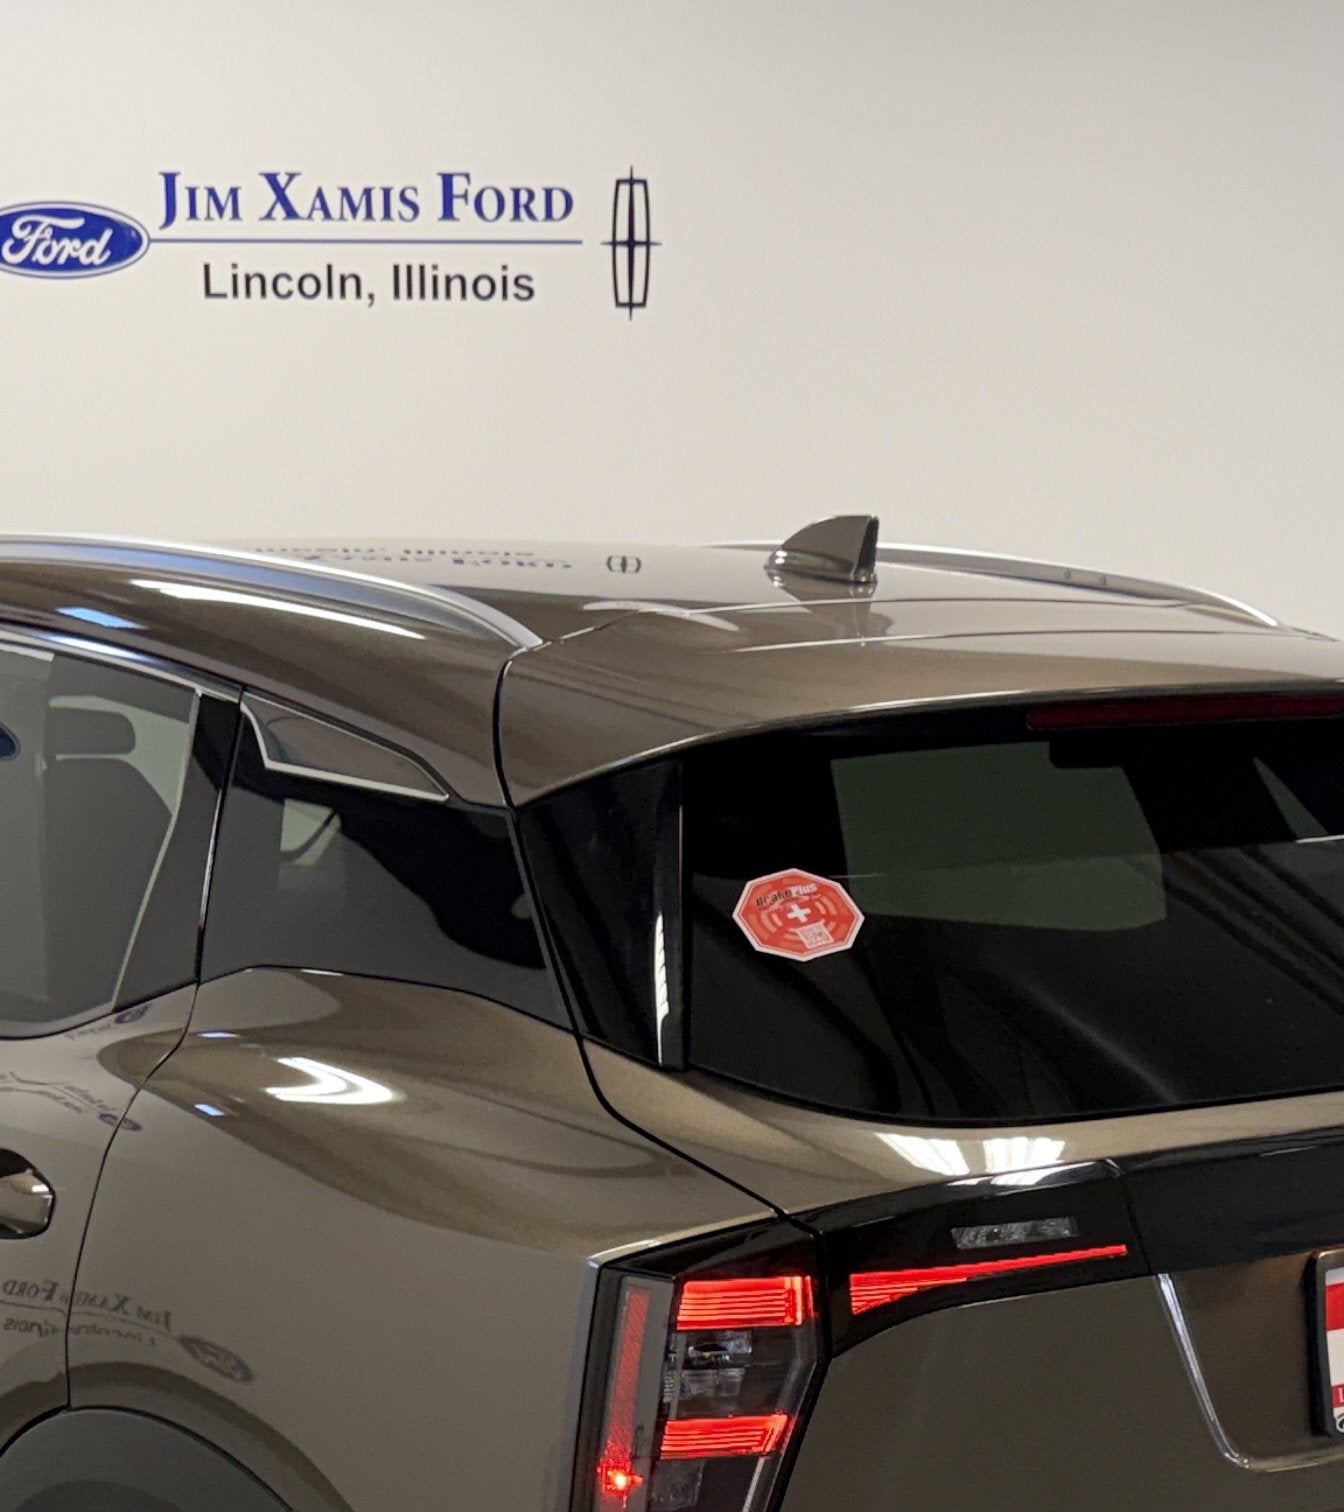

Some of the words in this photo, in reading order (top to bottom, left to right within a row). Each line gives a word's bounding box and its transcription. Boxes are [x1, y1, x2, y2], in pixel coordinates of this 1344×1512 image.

[158, 171, 242, 230] JIM
[259, 171, 420, 223] XAMIS
[437, 171, 574, 223] FORD
[0, 215, 112, 266] Ford
[204, 263, 376, 306] Lincoln,
[393, 263, 536, 300] Illinois
